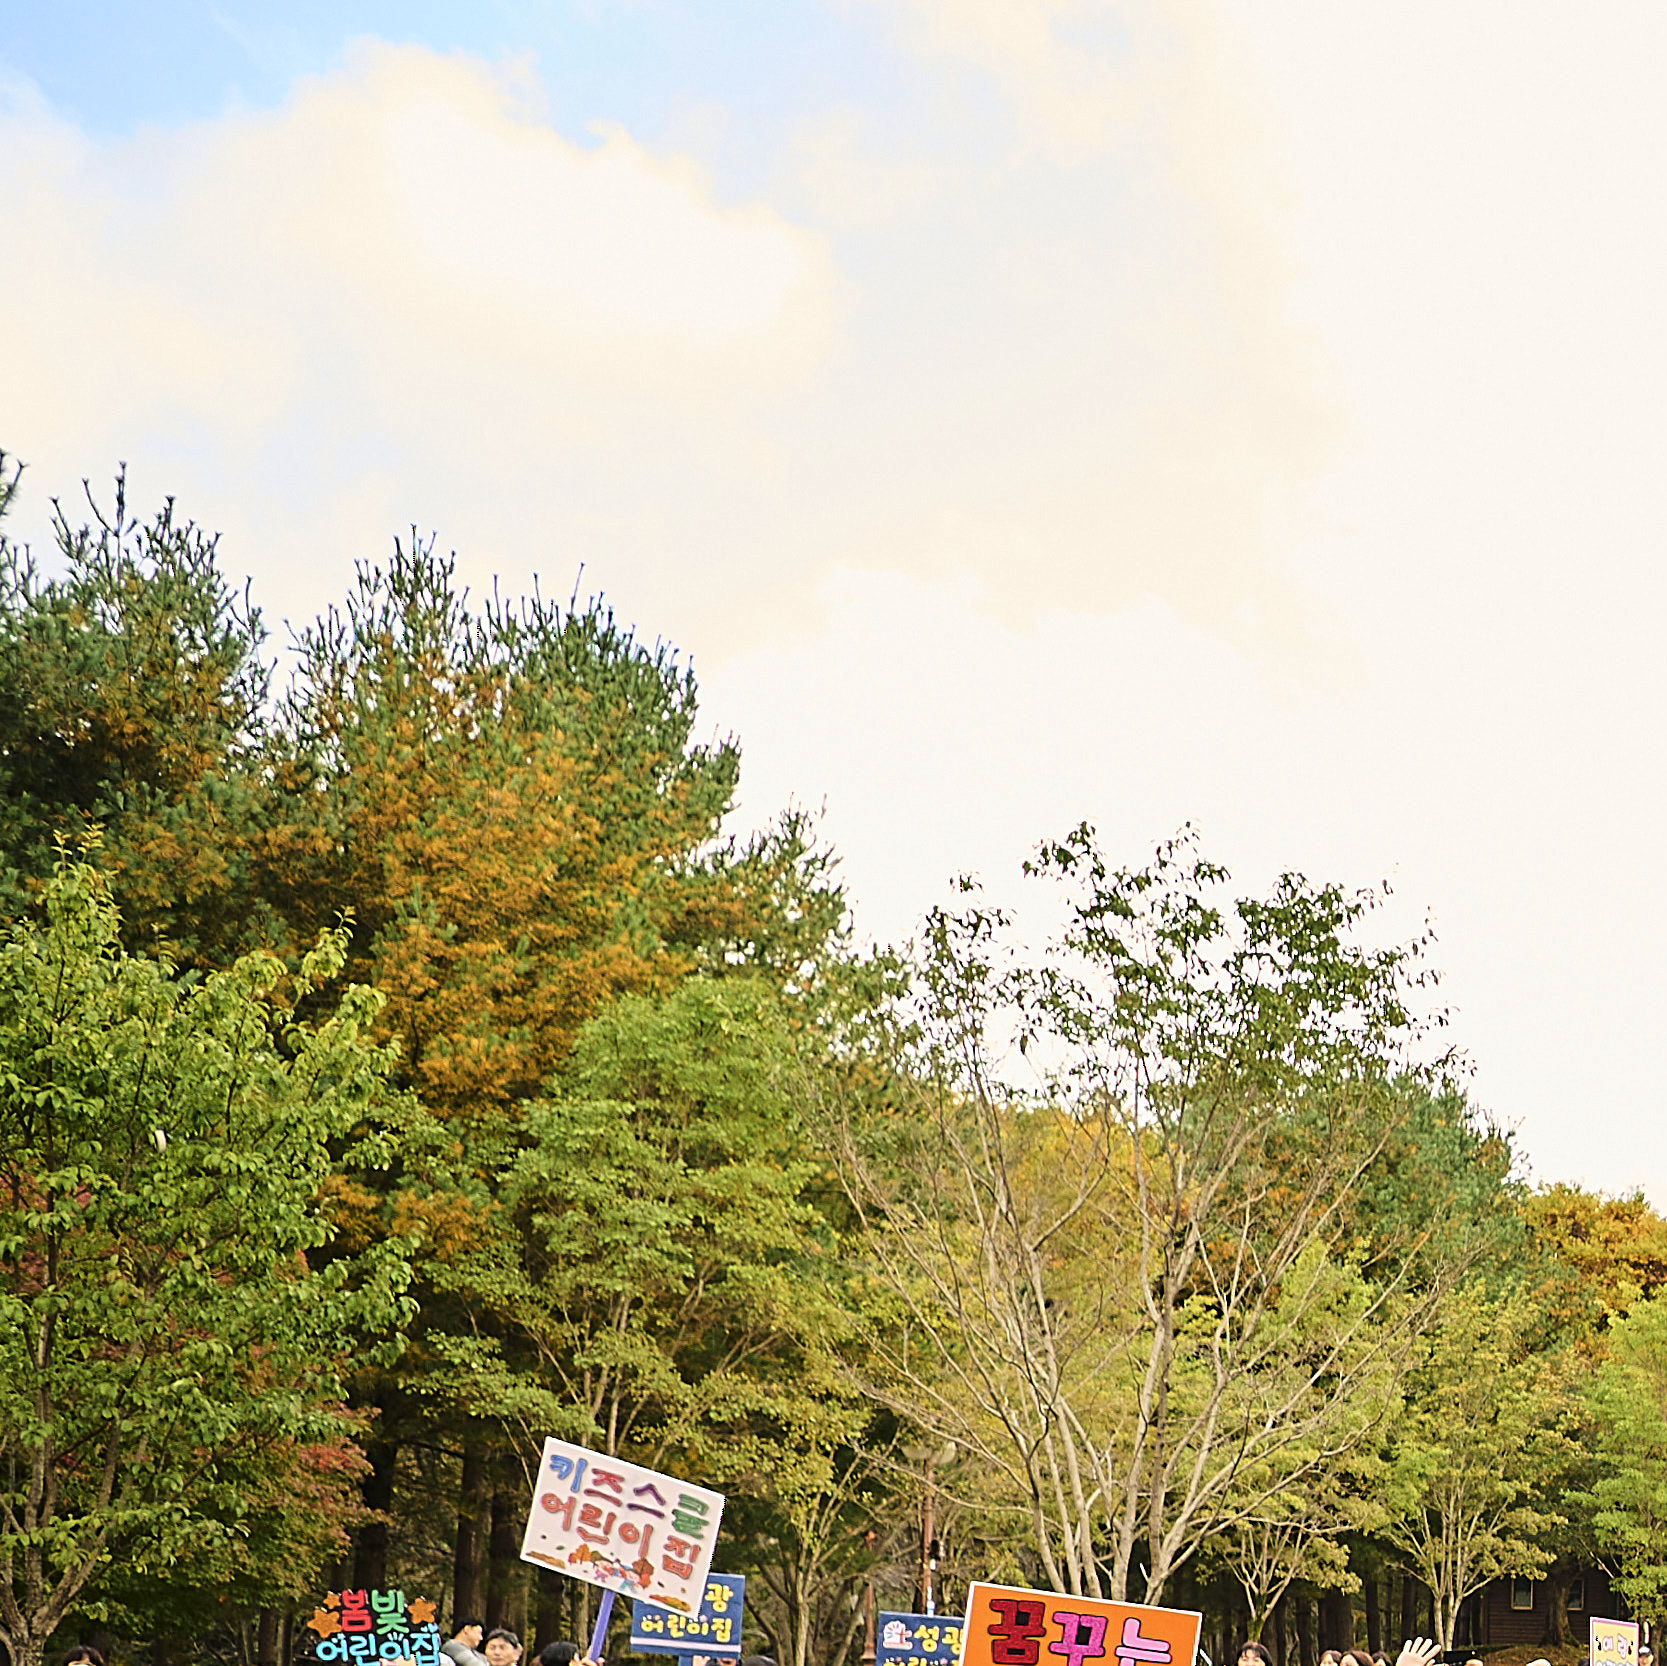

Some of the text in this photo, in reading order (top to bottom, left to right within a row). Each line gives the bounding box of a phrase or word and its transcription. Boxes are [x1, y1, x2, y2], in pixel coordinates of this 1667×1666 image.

[541, 1493, 701, 1580] 어린이집
[341, 1589, 410, 1635] 봄빛
[640, 1614, 732, 1643] 어린이집
